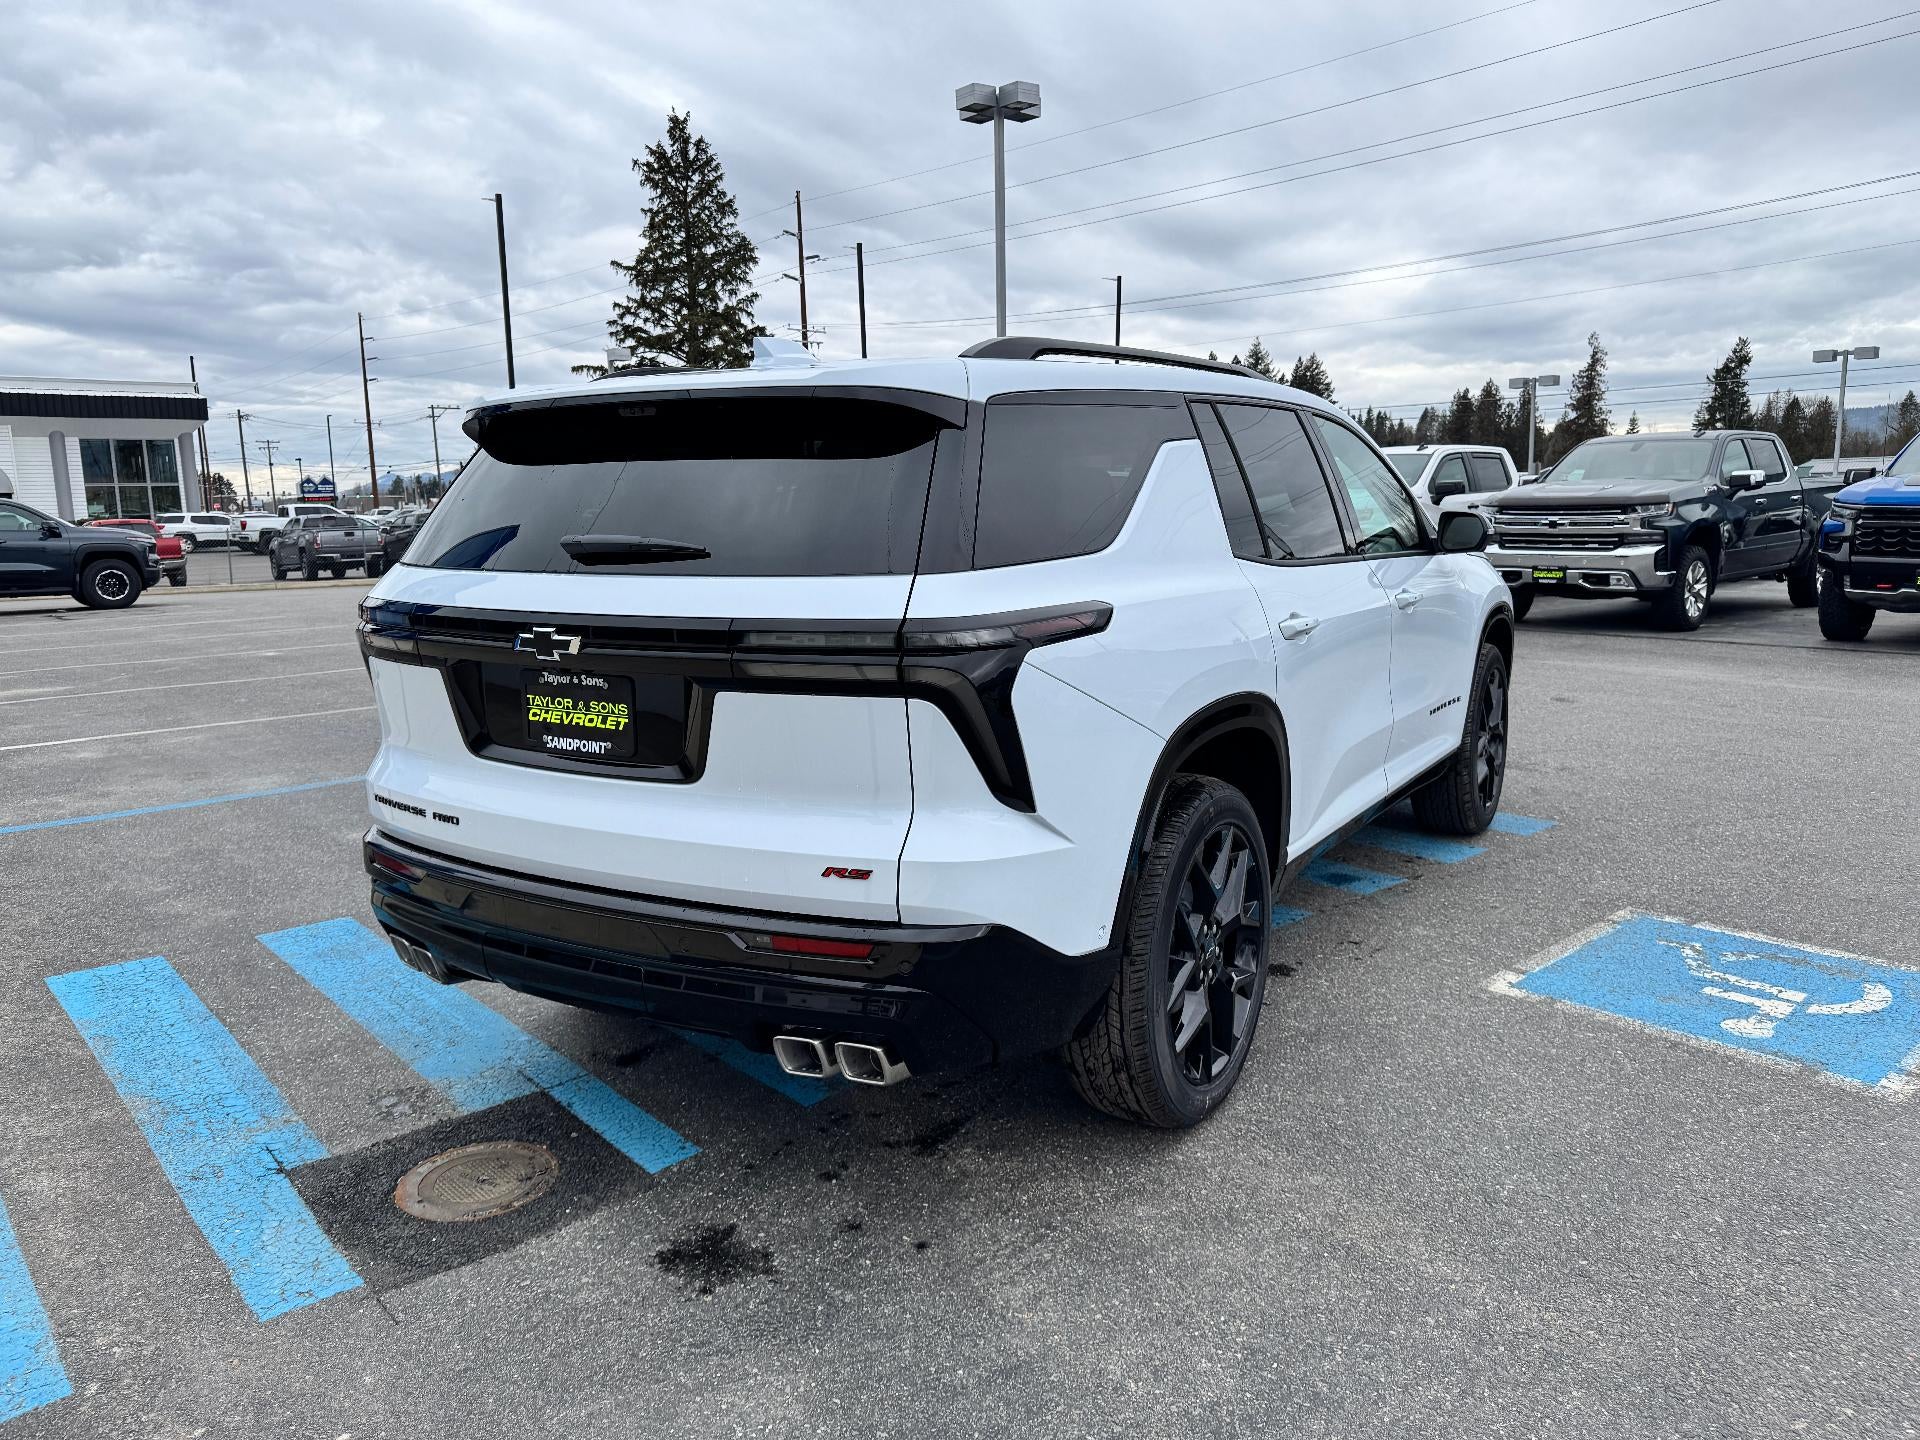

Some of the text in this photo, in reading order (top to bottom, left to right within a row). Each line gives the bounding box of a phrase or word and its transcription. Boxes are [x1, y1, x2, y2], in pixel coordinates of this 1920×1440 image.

[541, 672, 604, 687] Taylor & Sons
[527, 694, 629, 715] TAYLOR & SONS
[528, 708, 629, 731] CHEVROLET
[546, 735, 607, 754] SANDPOINT
[374, 793, 427, 818] TRAVERSE
[820, 866, 873, 880] RS
